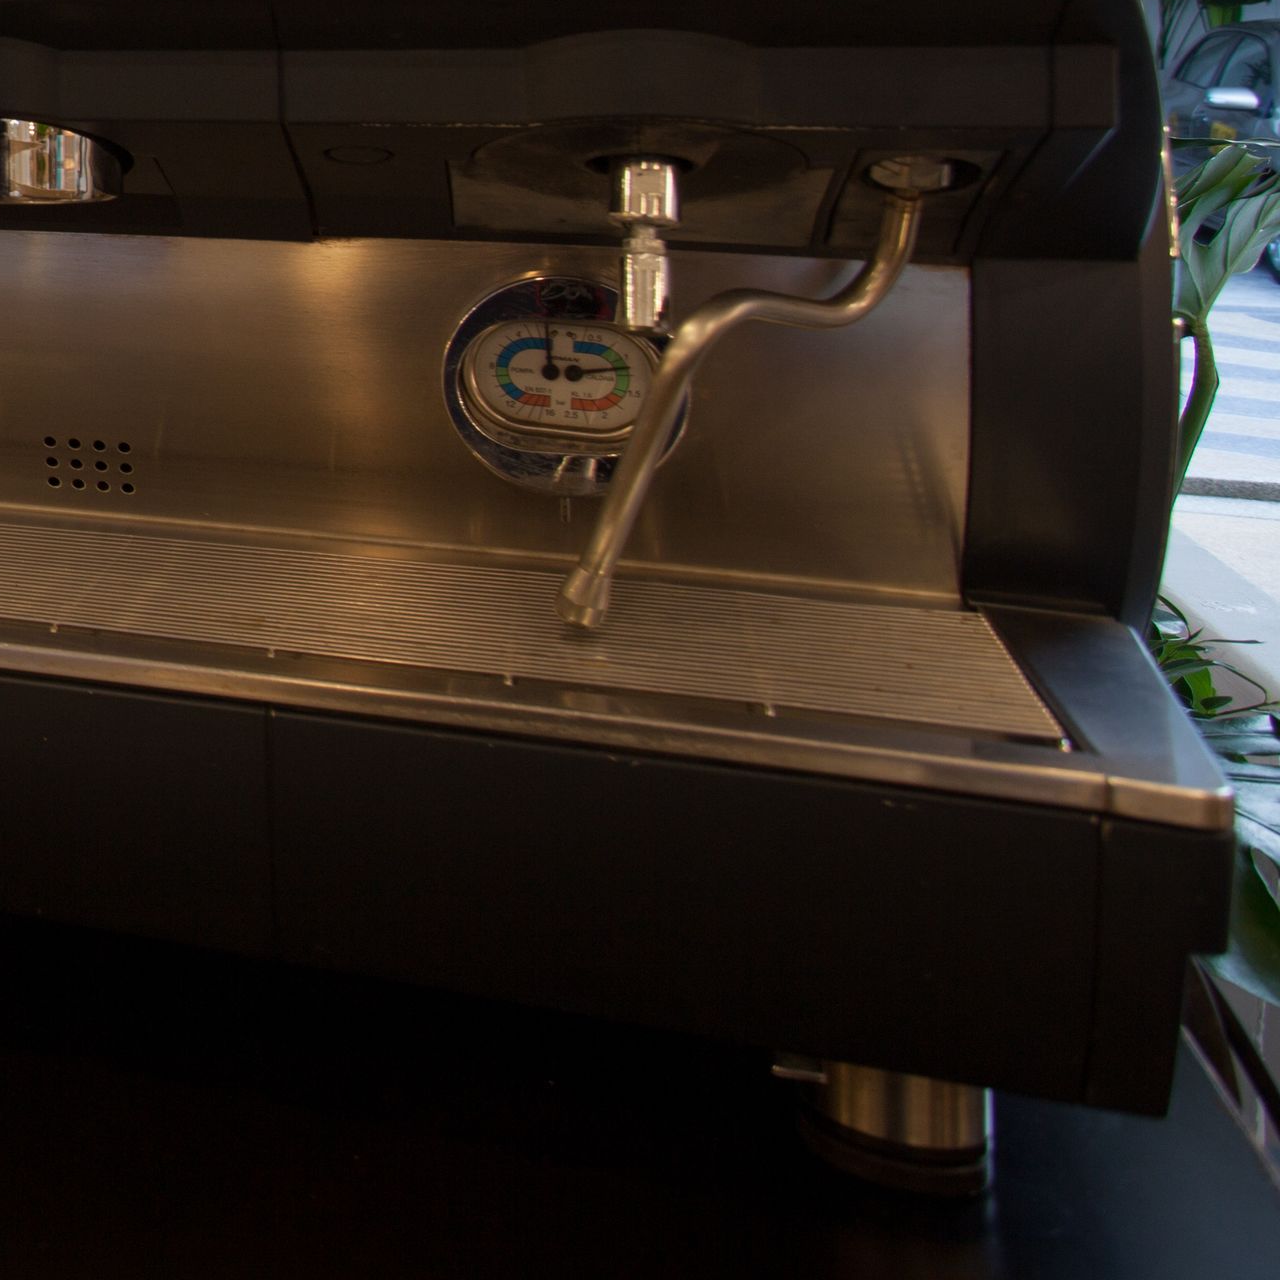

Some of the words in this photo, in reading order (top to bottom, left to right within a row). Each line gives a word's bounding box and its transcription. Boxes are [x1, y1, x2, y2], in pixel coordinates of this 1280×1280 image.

[505, 400, 517, 409] 12
[545, 409, 556, 417] 16
[564, 409, 579, 419] 2.5
[600, 412, 608, 420] 2
